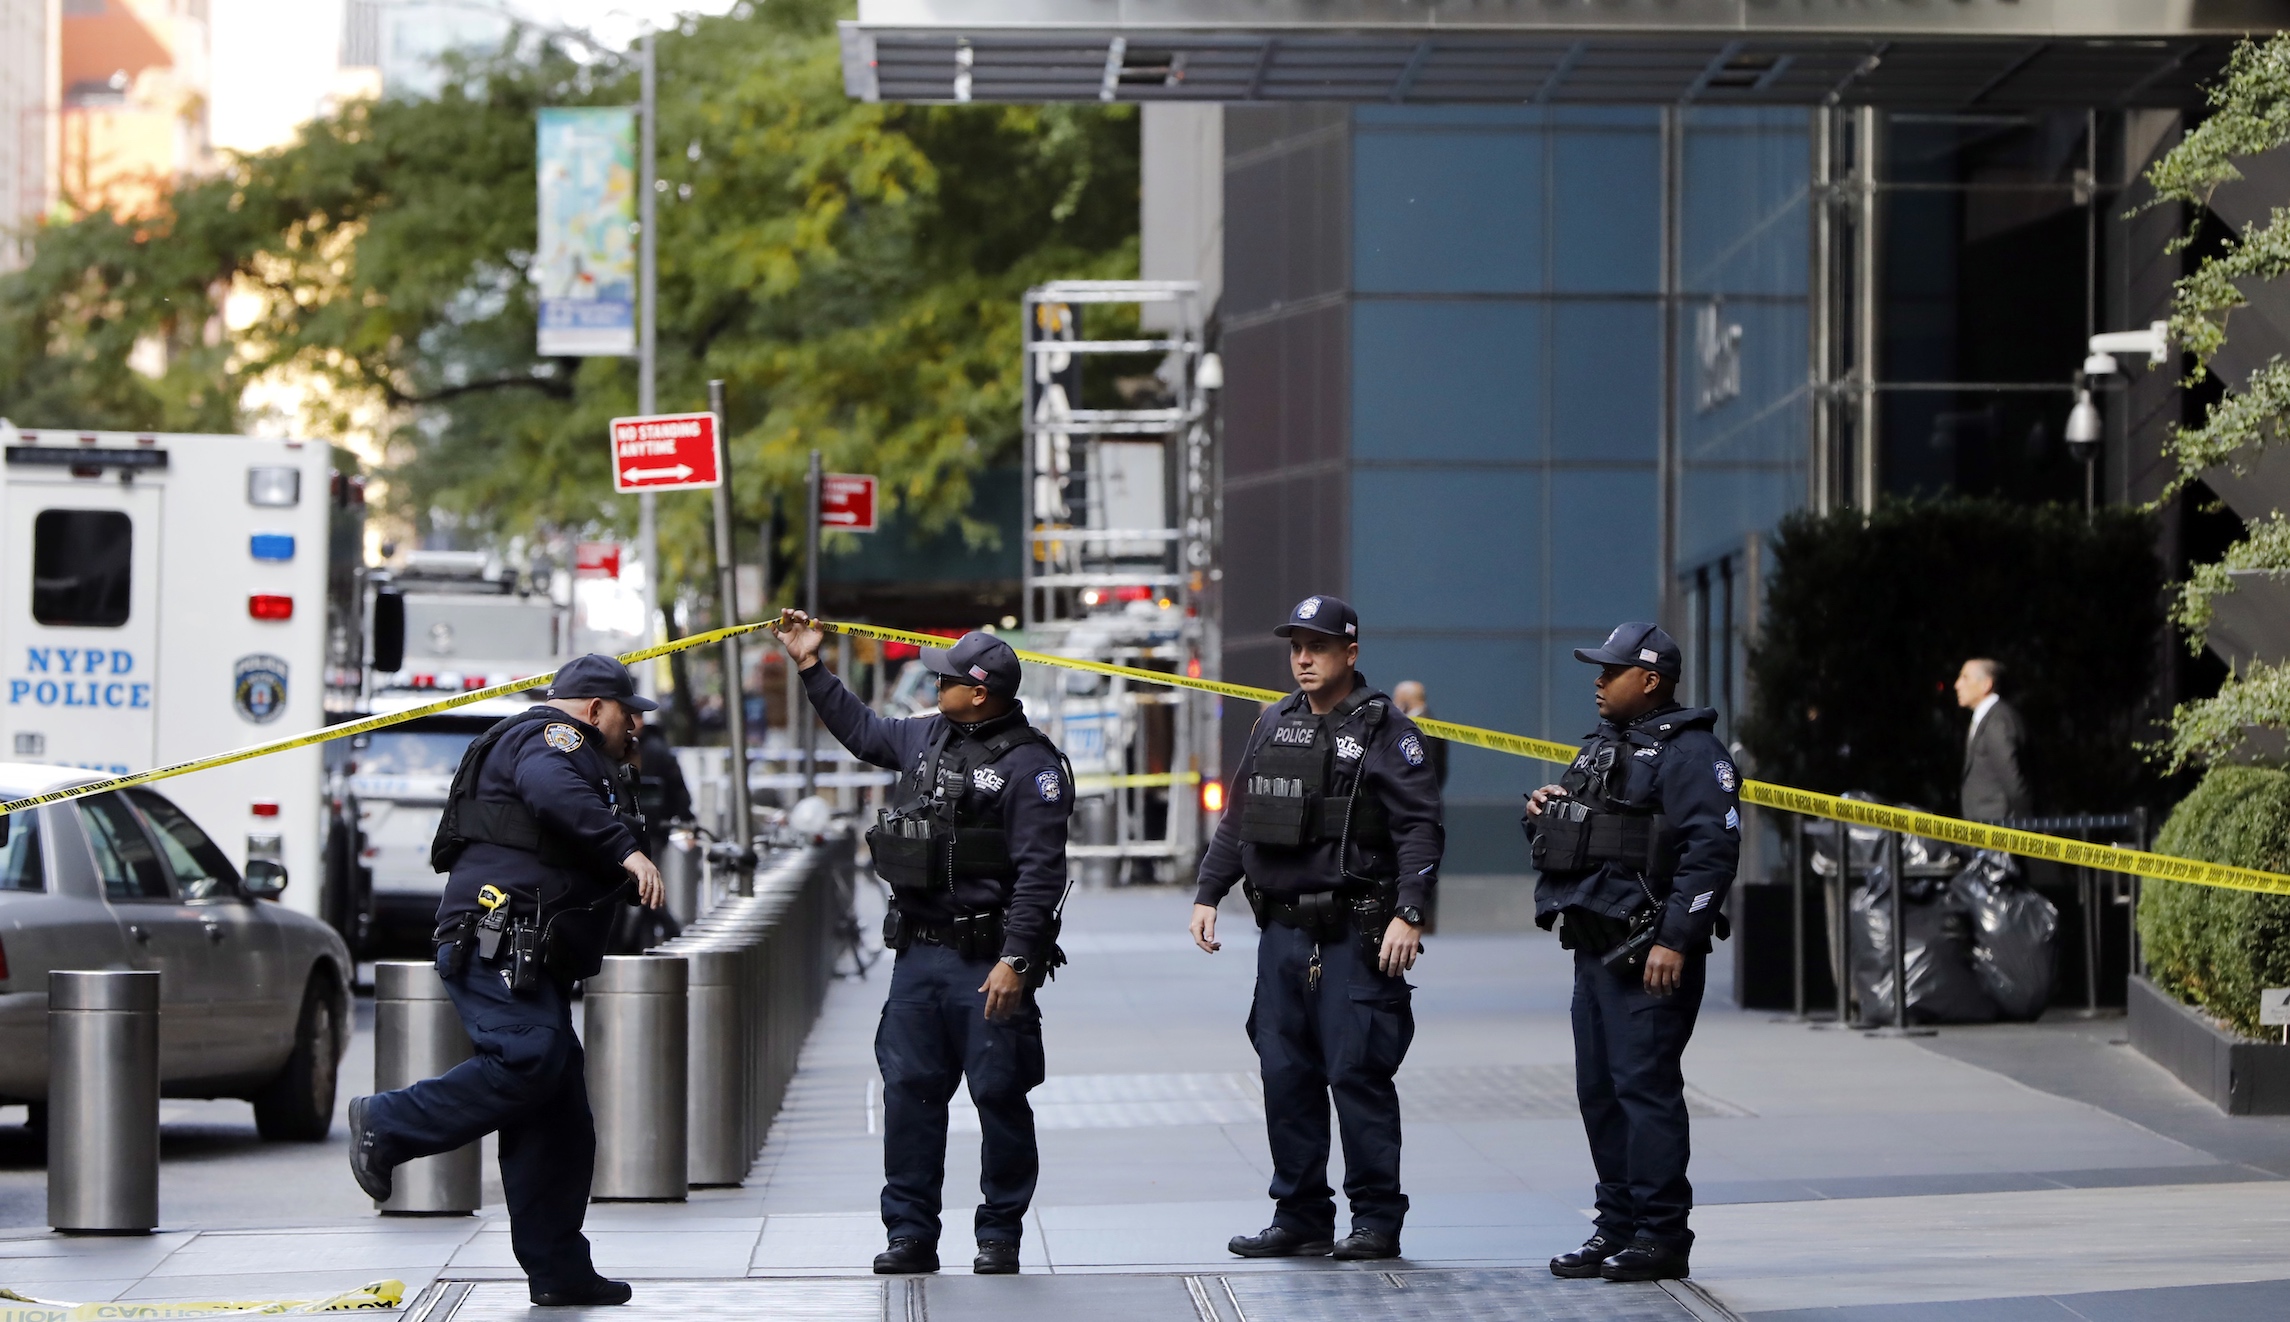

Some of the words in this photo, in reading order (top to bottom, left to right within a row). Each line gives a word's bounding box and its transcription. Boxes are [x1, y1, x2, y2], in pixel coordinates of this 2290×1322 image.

[617, 425, 637, 442] NO
[638, 421, 701, 441] STANDING
[619, 438, 677, 458] ANYTIME
[26, 648, 134, 675] NYPD
[9, 679, 151, 709] POLICE
[1274, 727, 1315, 744] POLICE
